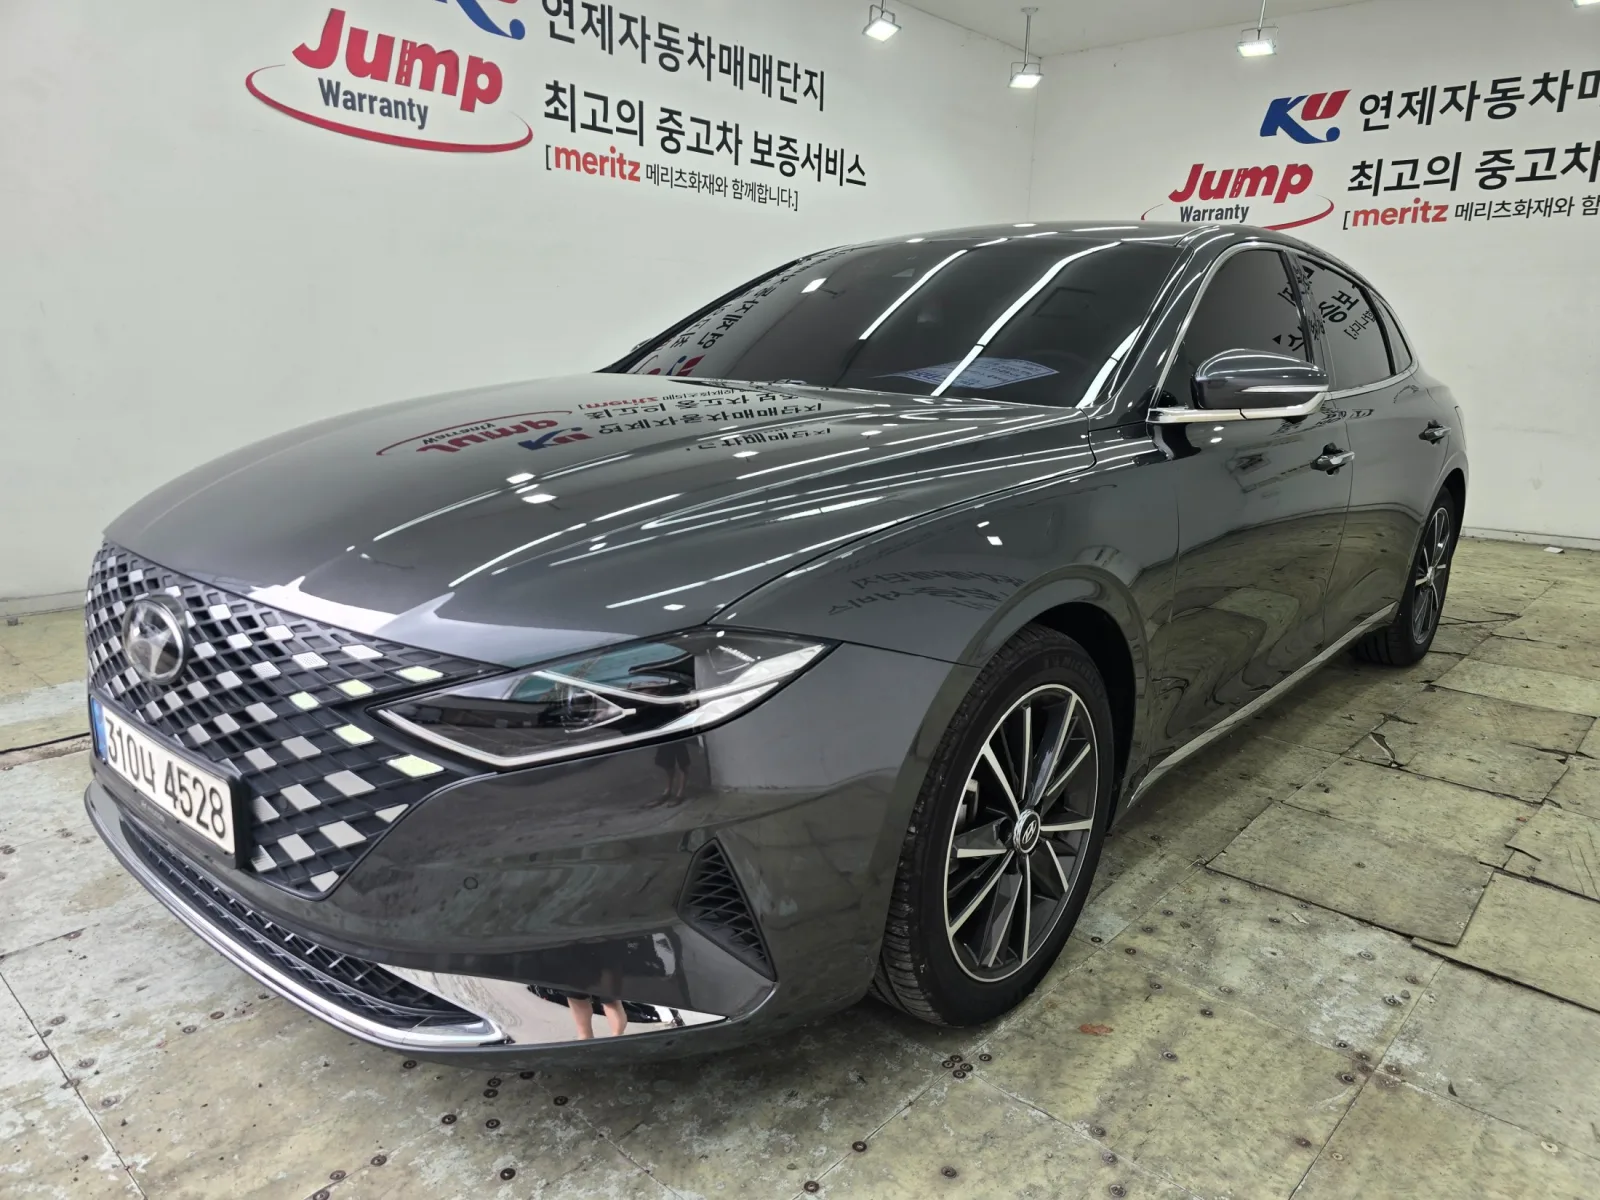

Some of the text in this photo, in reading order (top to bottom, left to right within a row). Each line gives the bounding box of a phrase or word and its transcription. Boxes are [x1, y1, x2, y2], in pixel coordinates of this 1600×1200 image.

[292, 8, 504, 113] Jump
[542, 0, 825, 111] 연제자동차매매단지
[317, 77, 429, 130] Warranty
[544, 80, 868, 187] 최고의 중고차 보증서비스
[645, 163, 728, 198] 메리츠화재와
[1168, 163, 1313, 204] Jump
[1347, 151, 1462, 197] 최고의
[1179, 204, 1250, 223] Warranty
[1454, 195, 1576, 222] 메리츠화재와
[164, 759, 227, 839] 4528
